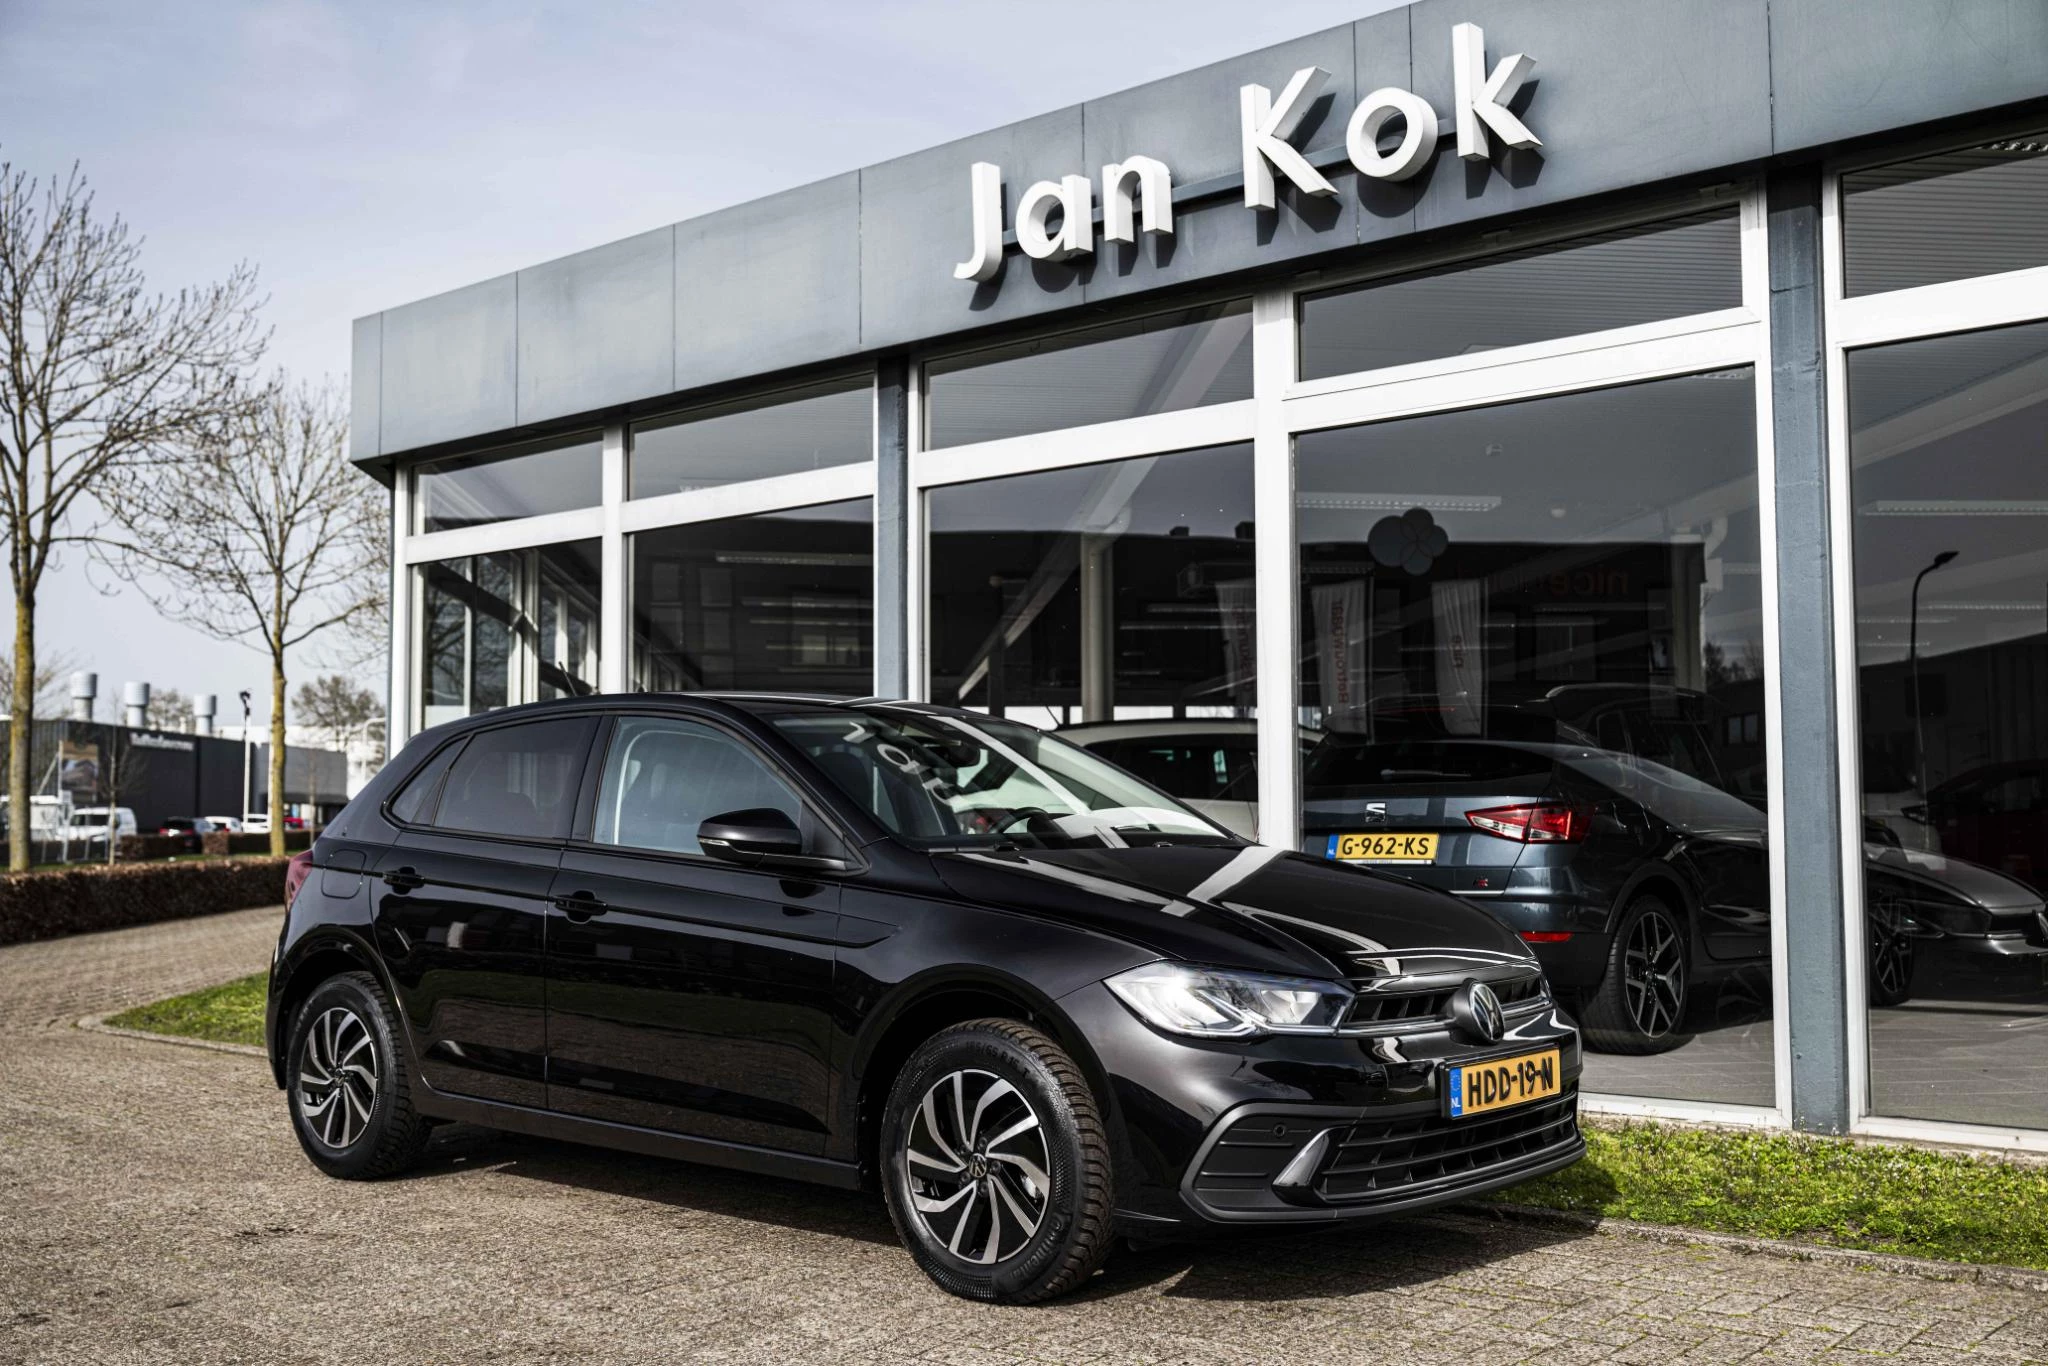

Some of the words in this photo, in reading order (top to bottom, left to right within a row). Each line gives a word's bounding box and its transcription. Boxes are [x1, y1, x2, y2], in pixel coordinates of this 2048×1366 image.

[954, 155, 1173, 283] Jan
[1240, 22, 1543, 212] Kok
[1342, 837, 1430, 856] G-962-KS
[1467, 1056, 1554, 1107] HDD-19-N
[1451, 1097, 1461, 1109] NL
